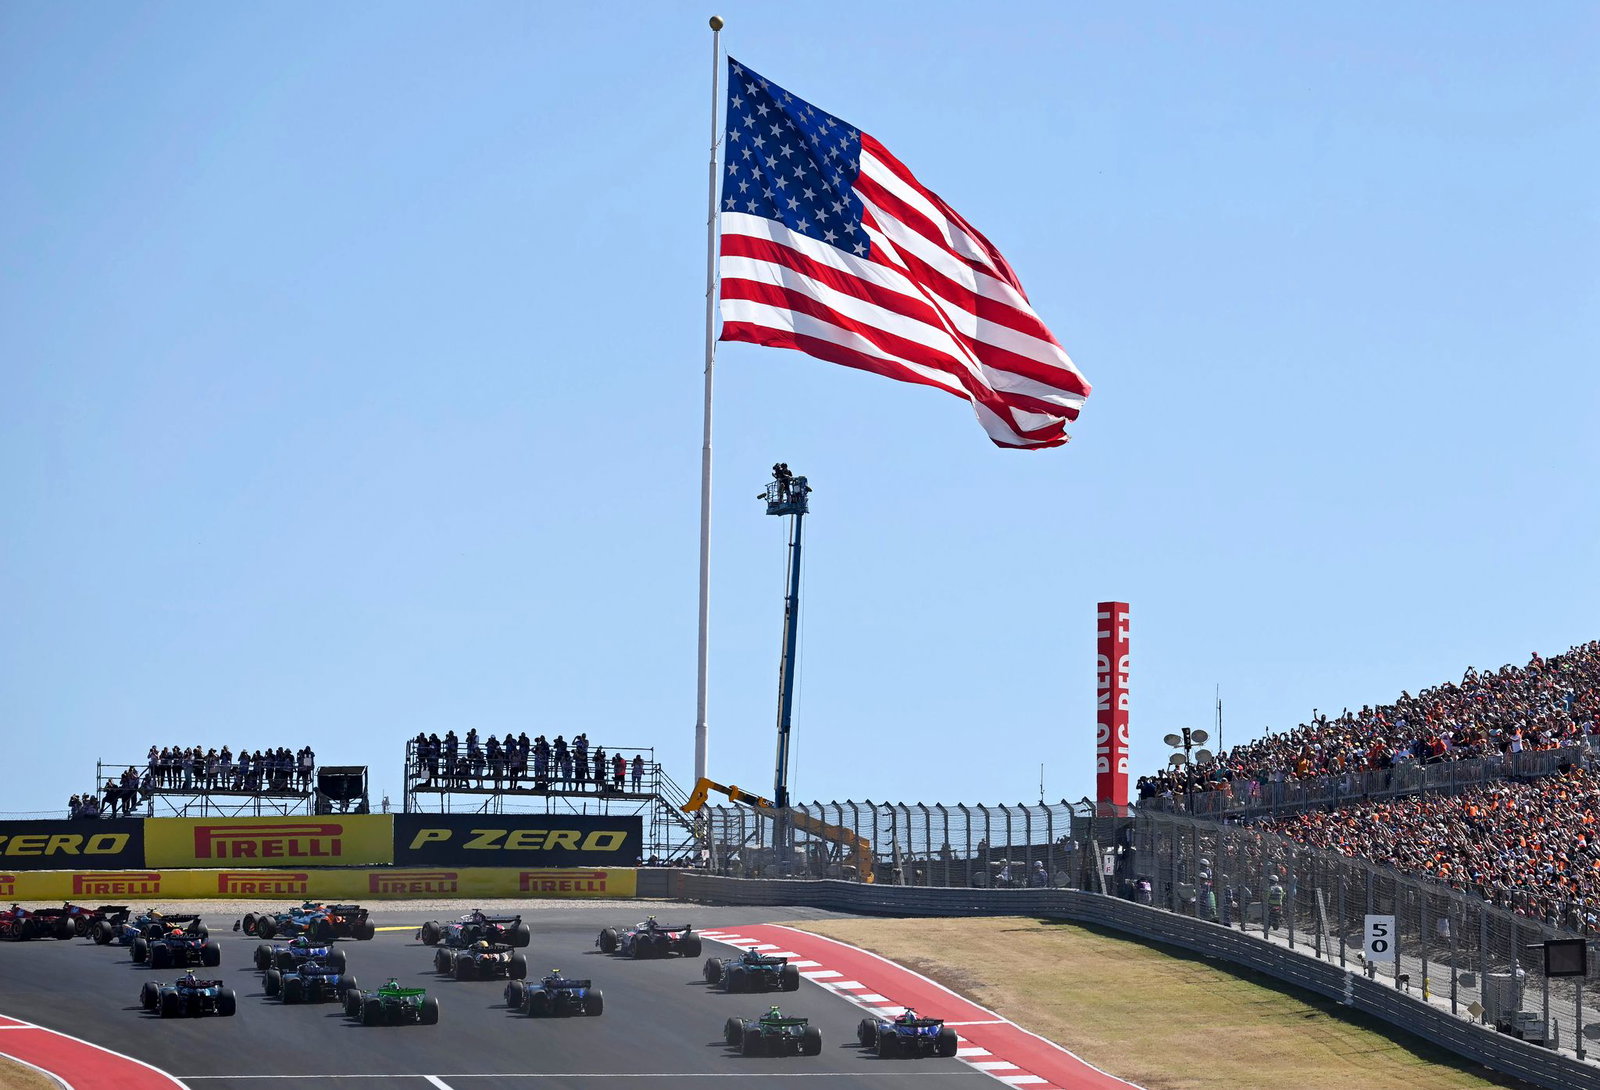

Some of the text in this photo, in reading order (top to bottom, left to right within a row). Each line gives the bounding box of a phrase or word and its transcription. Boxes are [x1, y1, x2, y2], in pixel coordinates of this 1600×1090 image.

[194, 824, 343, 858] PIRELLI
[409, 829, 628, 851] P ZERO
[73, 873, 161, 895] PIRELLI
[218, 873, 308, 894] PIRELLI
[369, 872, 458, 893] PIRELLI
[519, 871, 608, 892] PIRELLI
